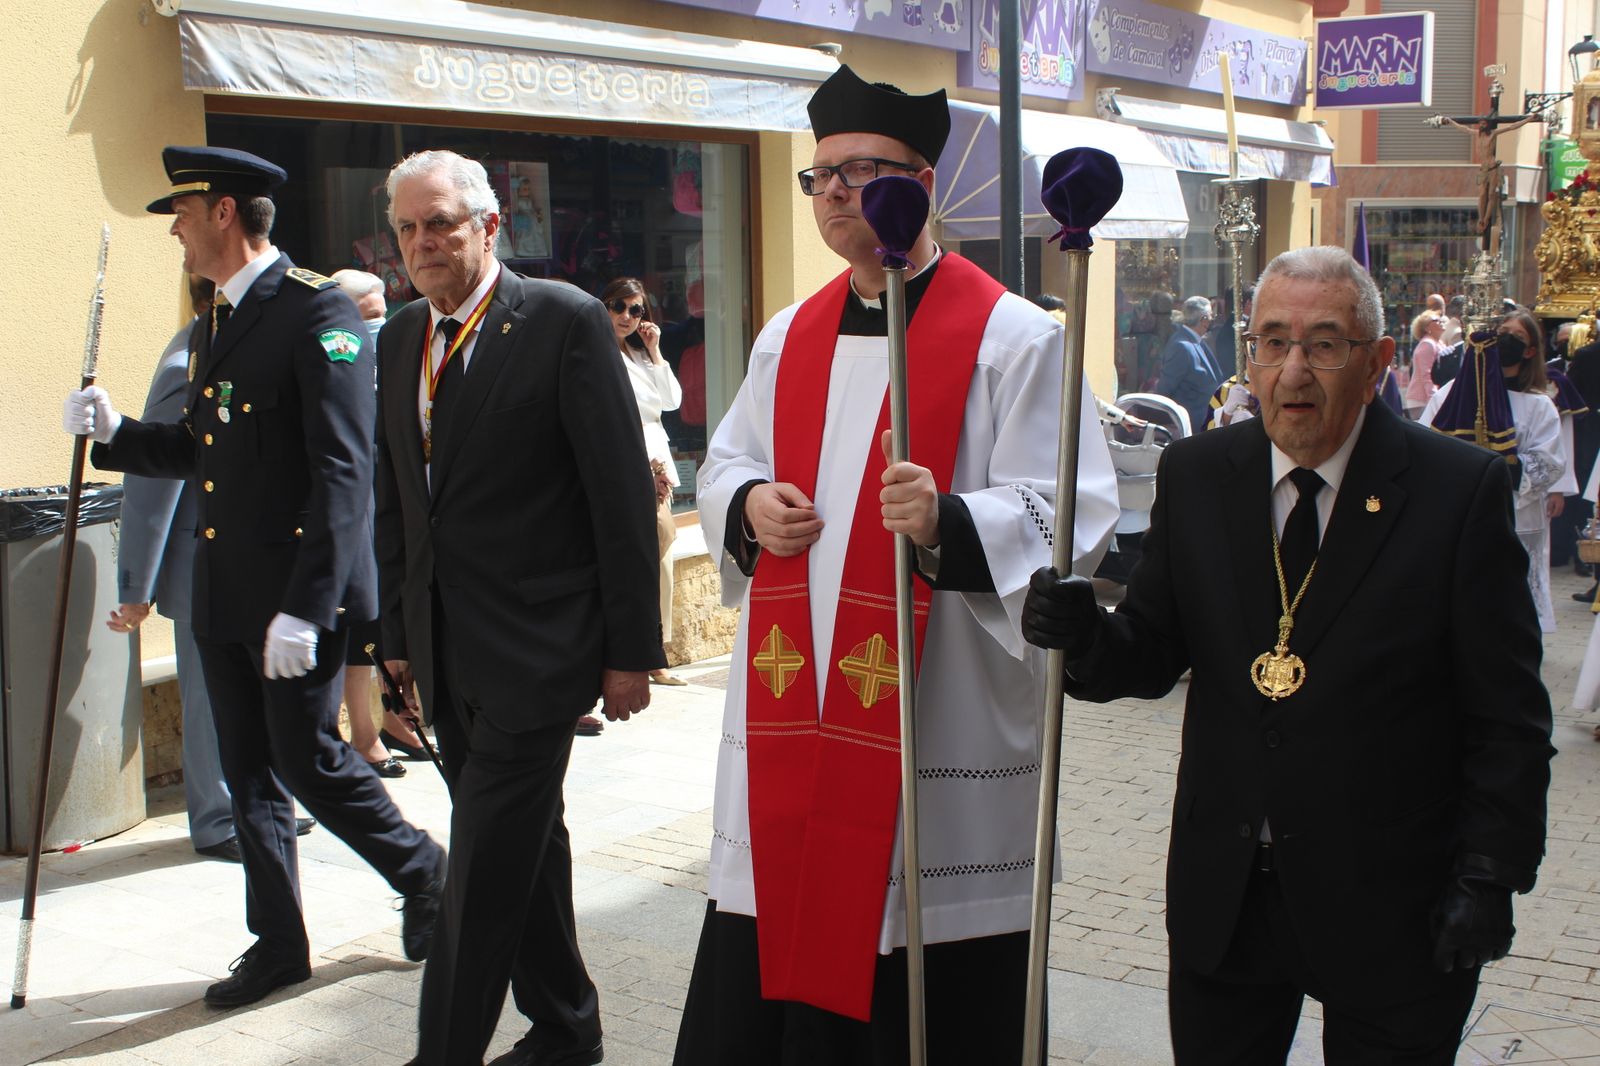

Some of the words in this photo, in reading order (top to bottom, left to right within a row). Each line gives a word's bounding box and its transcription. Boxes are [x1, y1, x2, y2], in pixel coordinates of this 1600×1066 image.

[1110, 8, 1170, 39] Complementos
[978, 39, 1075, 86] jueteria
[1113, 40, 1124, 60] de
[1127, 42, 1166, 68] Carnaval
[1264, 39, 1296, 66] Playa
